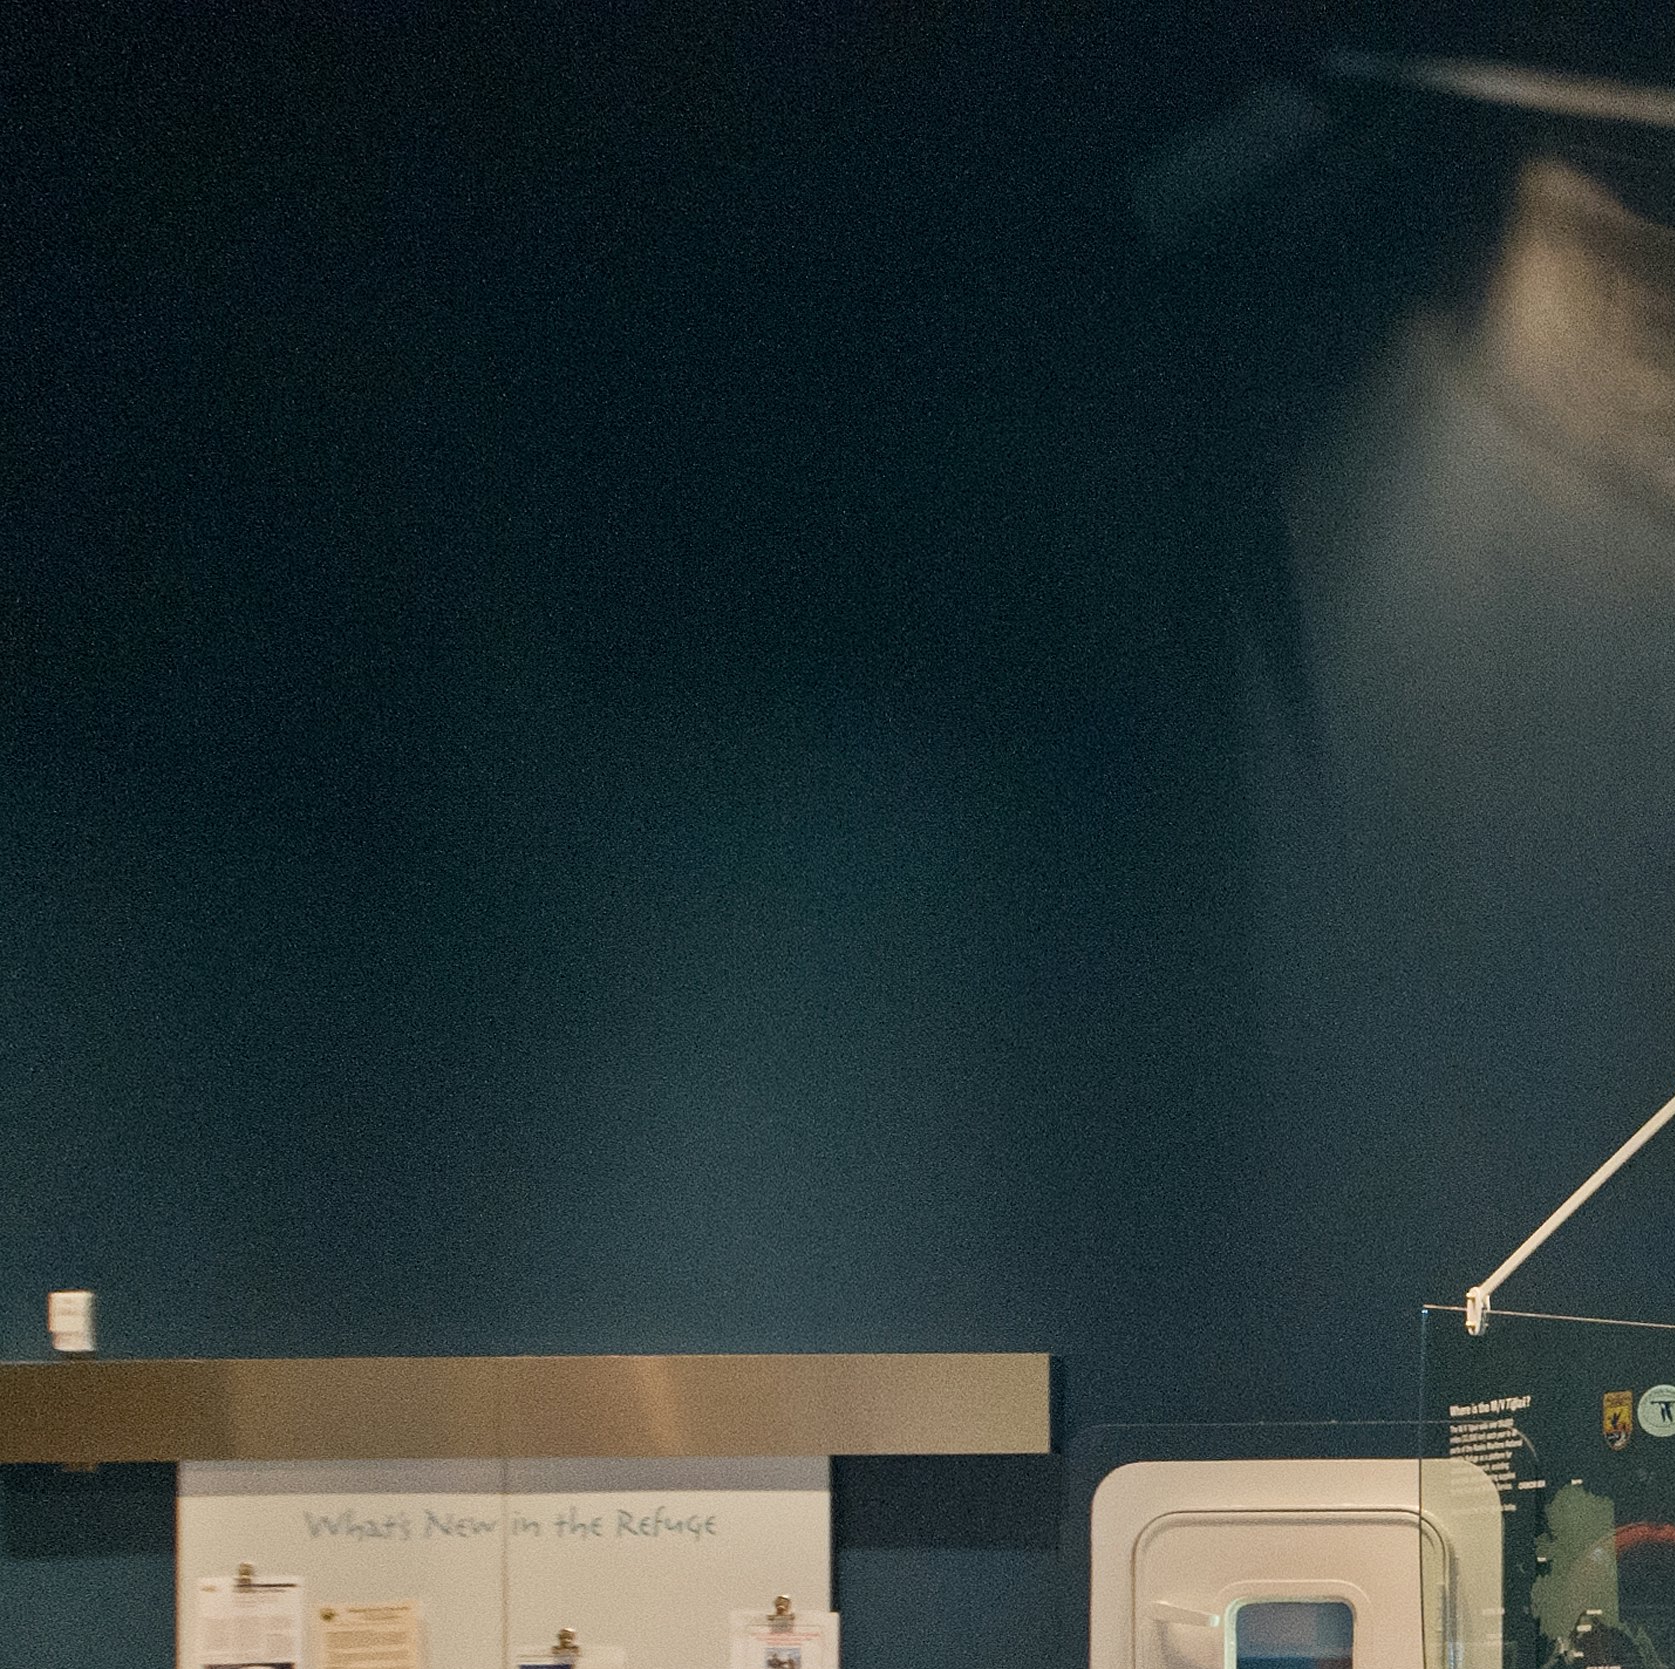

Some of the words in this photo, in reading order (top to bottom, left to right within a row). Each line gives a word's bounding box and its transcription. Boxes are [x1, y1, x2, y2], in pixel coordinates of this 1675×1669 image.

[423, 1508, 498, 1539] New
[511, 1510, 541, 1538] in
[554, 1506, 602, 1540] the
[616, 1506, 717, 1542] Refuge
